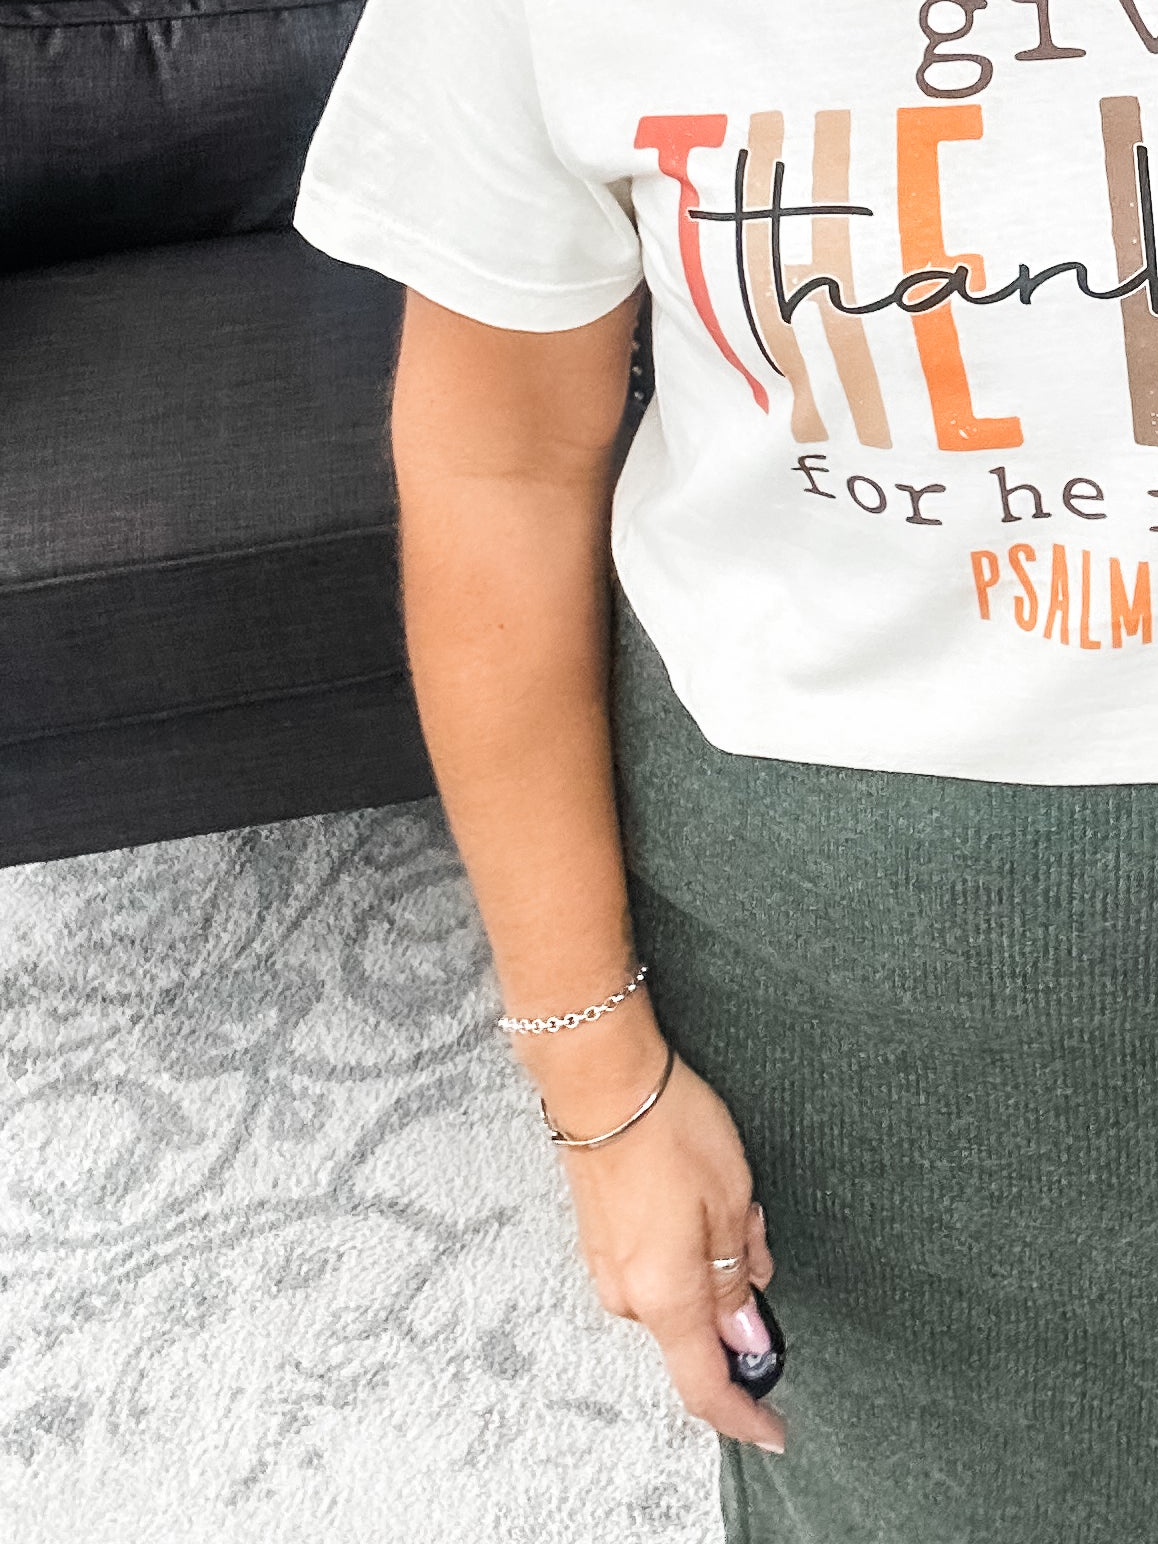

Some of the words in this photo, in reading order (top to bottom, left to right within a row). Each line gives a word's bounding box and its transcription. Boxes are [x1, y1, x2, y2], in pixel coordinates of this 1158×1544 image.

[632, 102, 1025, 453] THE
[791, 452, 948, 527] for
[988, 465, 1108, 524] he
[970, 542, 1154, 650] PSALM
